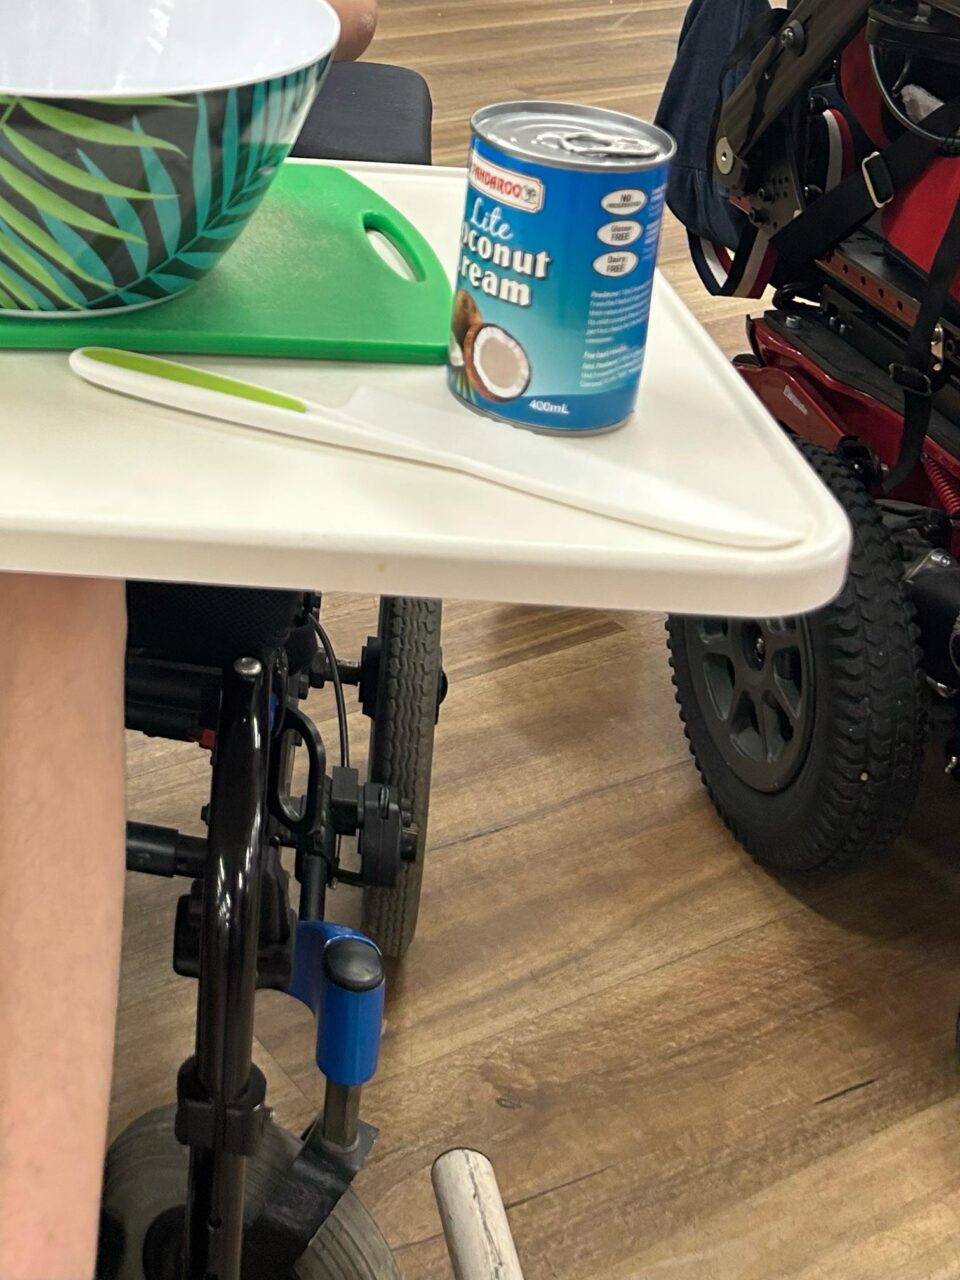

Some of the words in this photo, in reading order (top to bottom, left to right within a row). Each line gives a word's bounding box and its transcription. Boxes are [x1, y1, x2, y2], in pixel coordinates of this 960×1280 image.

[470, 197, 514, 239] Lite
[610, 231, 630, 241] FREE
[607, 255, 626, 265] Dairy
[606, 263, 625, 273] FREE
[529, 399, 570, 416] 400mL
